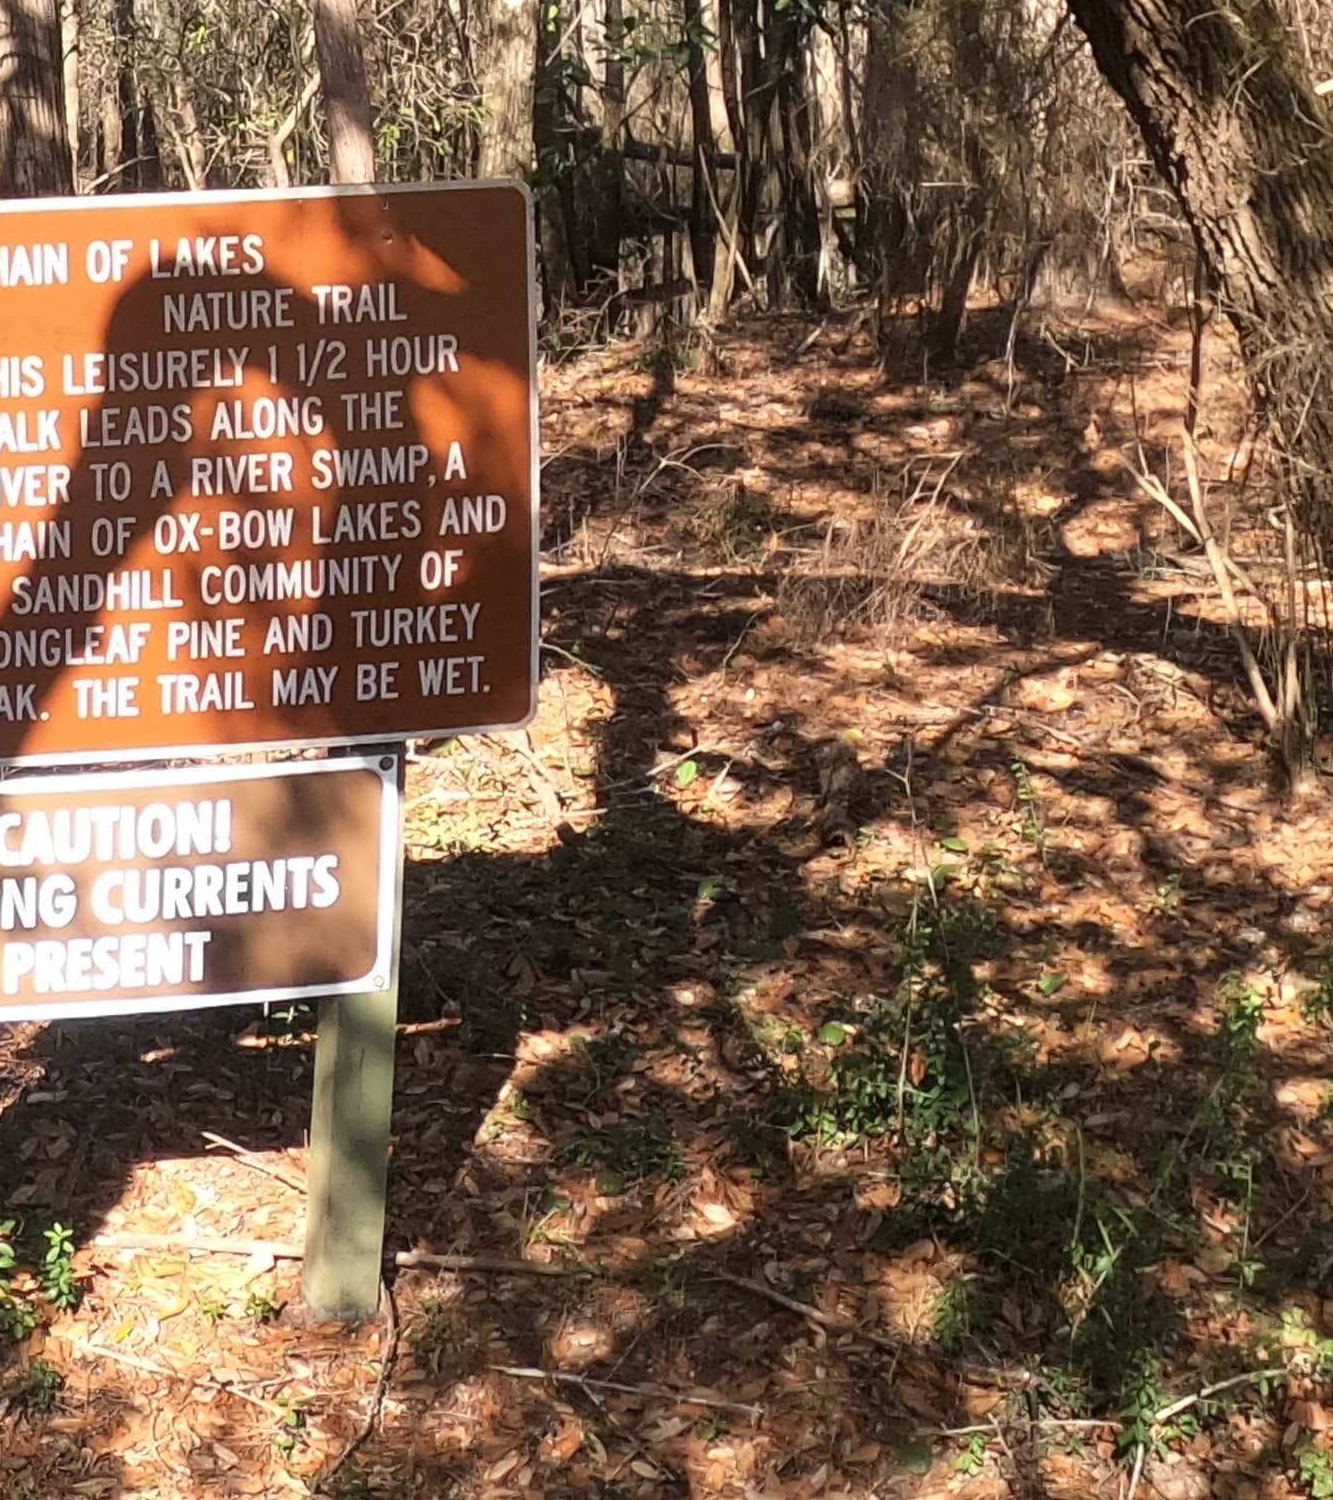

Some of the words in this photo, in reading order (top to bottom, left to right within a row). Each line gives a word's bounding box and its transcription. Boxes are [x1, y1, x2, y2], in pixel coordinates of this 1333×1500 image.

[86, 239, 133, 284] OF
[151, 235, 265, 279] LAKES
[163, 288, 294, 333] NATURE
[311, 283, 407, 325] TRAIL
[61, 348, 248, 396] LEISURELY
[268, 348, 277, 384] 1
[296, 340, 347, 387] 1/2
[365, 334, 458, 378] HOUR
[80, 405, 193, 448] LEADS
[210, 397, 324, 441] ALONG
[341, 391, 404, 431] THE
[91, 461, 131, 502] TO
[151, 460, 174, 499] A
[191, 453, 293, 497] RIVER
[311, 445, 436, 490] SWAMP,
[444, 442, 467, 481] A
[91, 517, 136, 557] OF
[154, 509, 294, 555] OX-BOW
[312, 501, 421, 545] LAKES
[439, 495, 507, 535] AND
[11, 569, 182, 615] SANDHILL
[200, 555, 402, 605] COMMUNITY
[420, 550, 464, 590] OF
[166, 618, 245, 661] PINE
[263, 614, 333, 655] AND
[351, 603, 481, 648] TURKEY
[73, 678, 139, 719] THE
[156, 672, 255, 714] TRAIL
[272, 666, 337, 707] MAY
[357, 663, 399, 701] BE
[419, 656, 491, 698] WET.
[90, 854, 340, 924] CURRENTS
[2, 930, 211, 995] PRESENT
